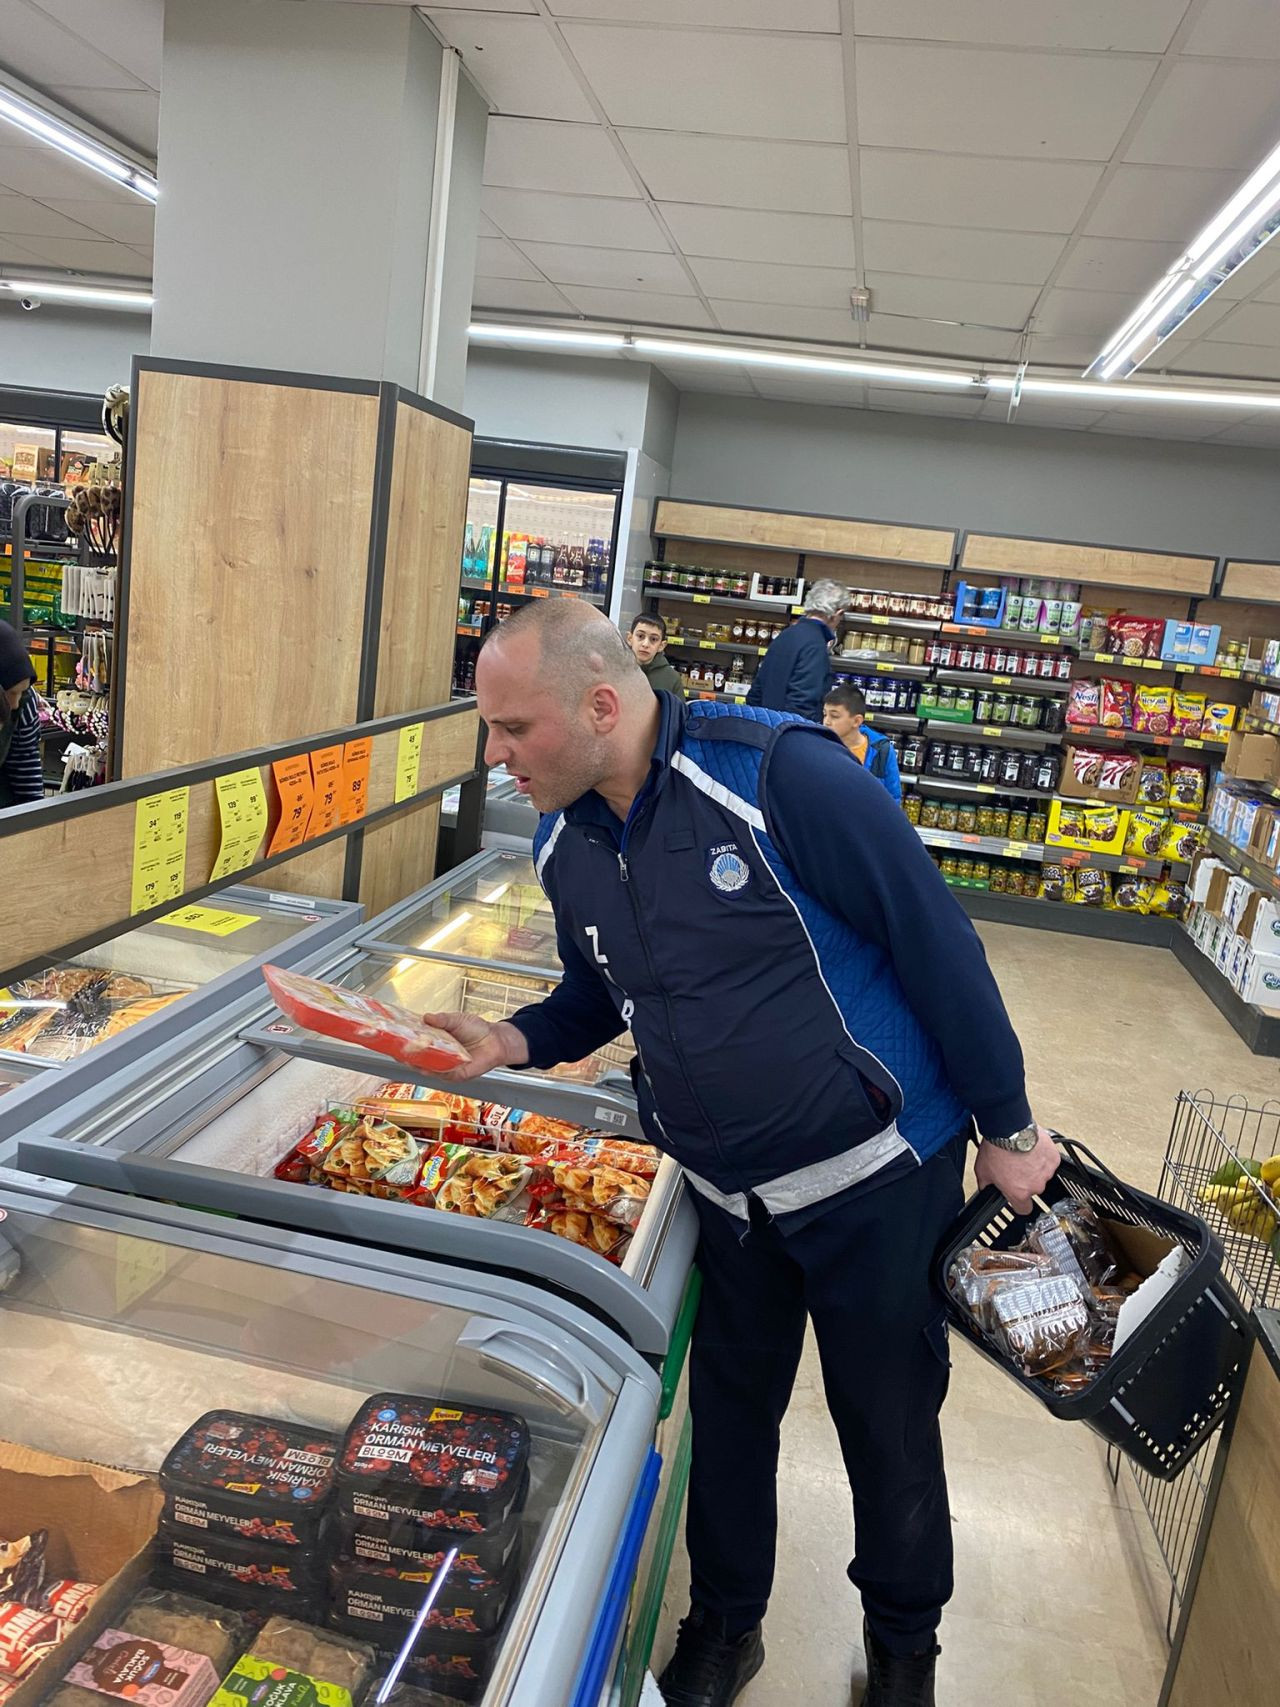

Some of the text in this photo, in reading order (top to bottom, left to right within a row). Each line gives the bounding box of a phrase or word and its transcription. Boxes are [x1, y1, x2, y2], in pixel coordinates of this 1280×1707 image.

[710, 844, 738, 855] ZABITA
[371, 1422, 426, 1437] KARIŞIK
[362, 1447, 408, 1461] BLOOM
[365, 1434, 496, 1464] ORMAN MEYVELERİ
[276, 1462, 328, 1478] ORMAN
[267, 1470, 321, 1487] KARIŞIK
[175, 1503, 205, 1518] ORMAN
[353, 1497, 386, 1510] ORMAN
[355, 1539, 387, 1552] ORMAN
[173, 1548, 204, 1563] ORMAN
[348, 1598, 381, 1611] ORMAN
[112, 1648, 145, 1684] BAKLAVA
[274, 1682, 297, 1707] KLAVA
